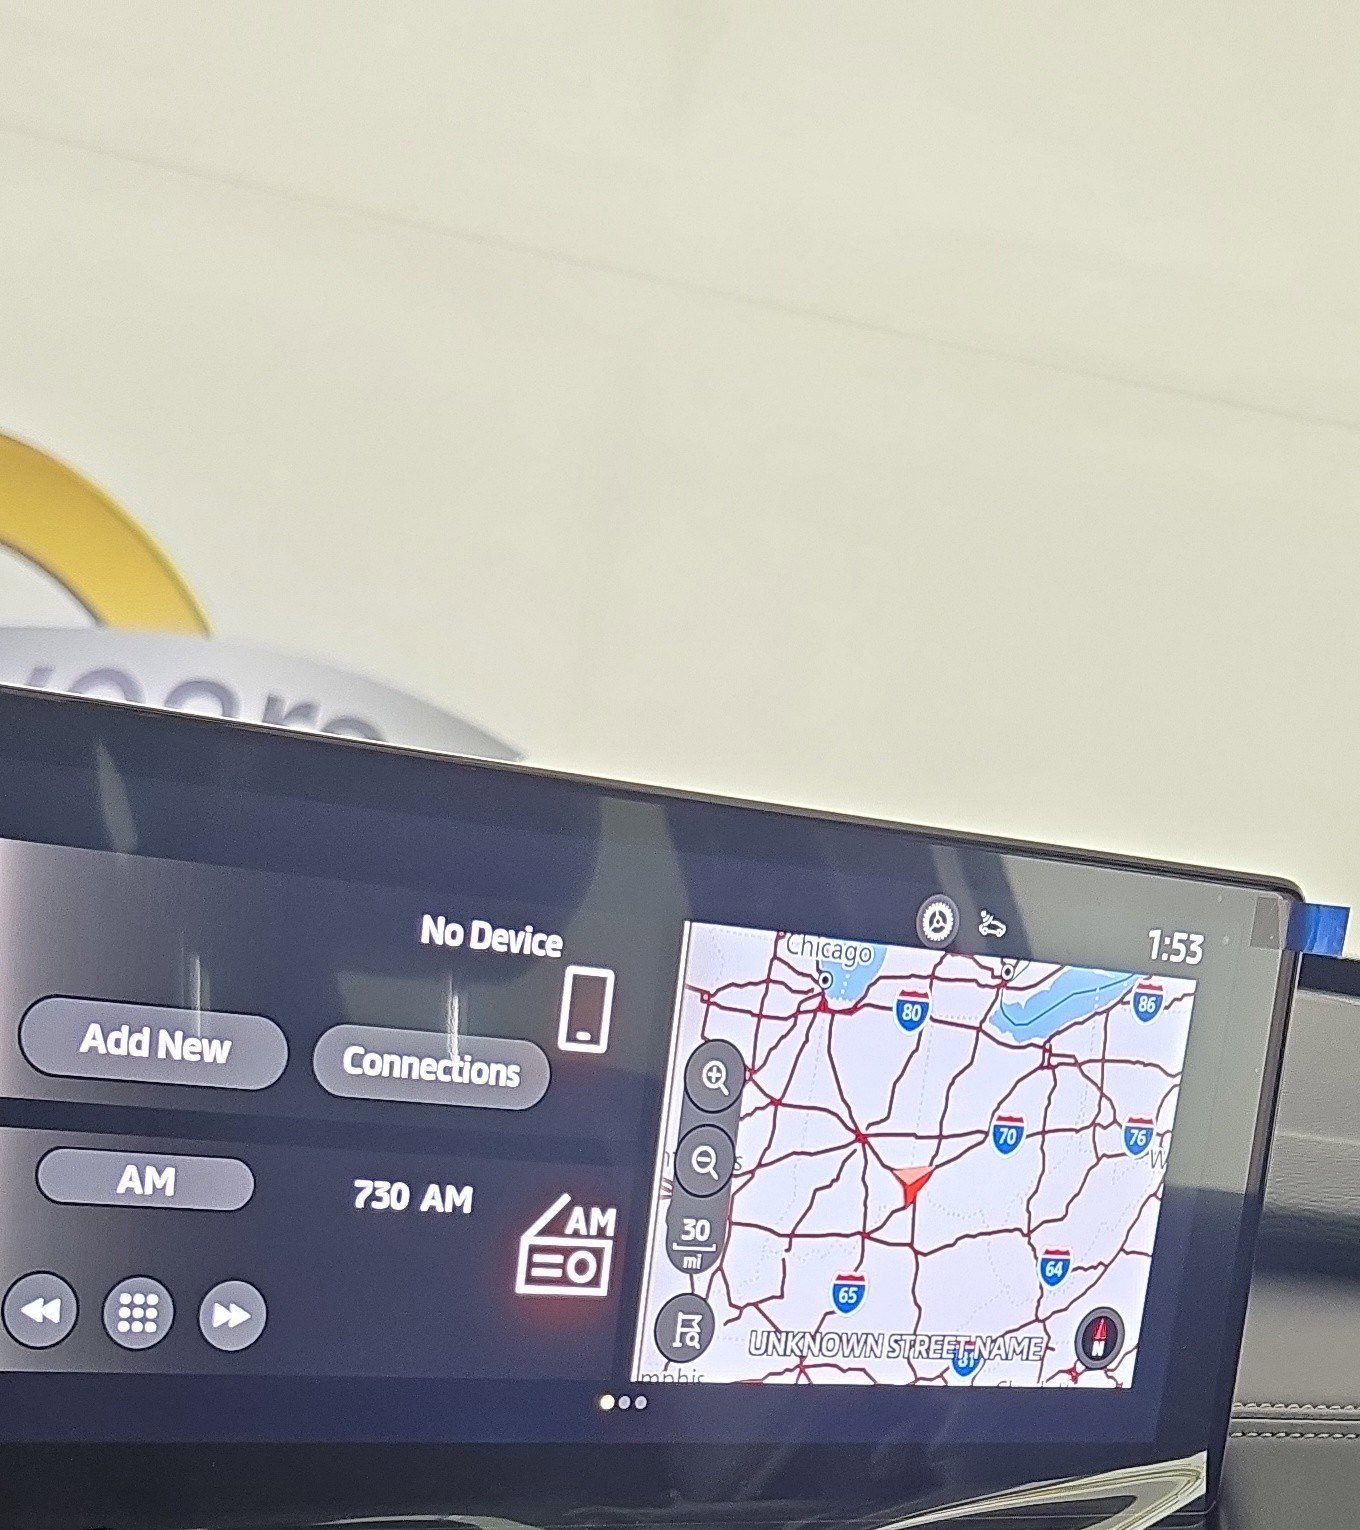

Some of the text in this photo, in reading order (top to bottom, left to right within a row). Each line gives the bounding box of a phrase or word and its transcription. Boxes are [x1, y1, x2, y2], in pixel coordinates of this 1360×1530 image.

[419, 913, 564, 959] No Device
[1147, 927, 1205, 965] 1:53
[785, 933, 874, 967] Chicago
[897, 1001, 923, 1023] 80
[1136, 994, 1158, 1015] 86
[79, 1022, 234, 1065] Add New
[342, 1044, 522, 1091] Connections
[997, 1128, 1018, 1147] 70
[1127, 1128, 1148, 1147] 76
[115, 1165, 176, 1198] AM
[351, 1179, 474, 1215] 730 AM
[564, 1207, 616, 1239] AM
[680, 1218, 711, 1241] 30
[683, 1253, 703, 1270] mi
[1044, 1261, 1064, 1279] 64
[838, 1286, 859, 1305] 65
[748, 1330, 1043, 1361] UNKNOWN STREET NAME
[1090, 1340, 1104, 1357] N
